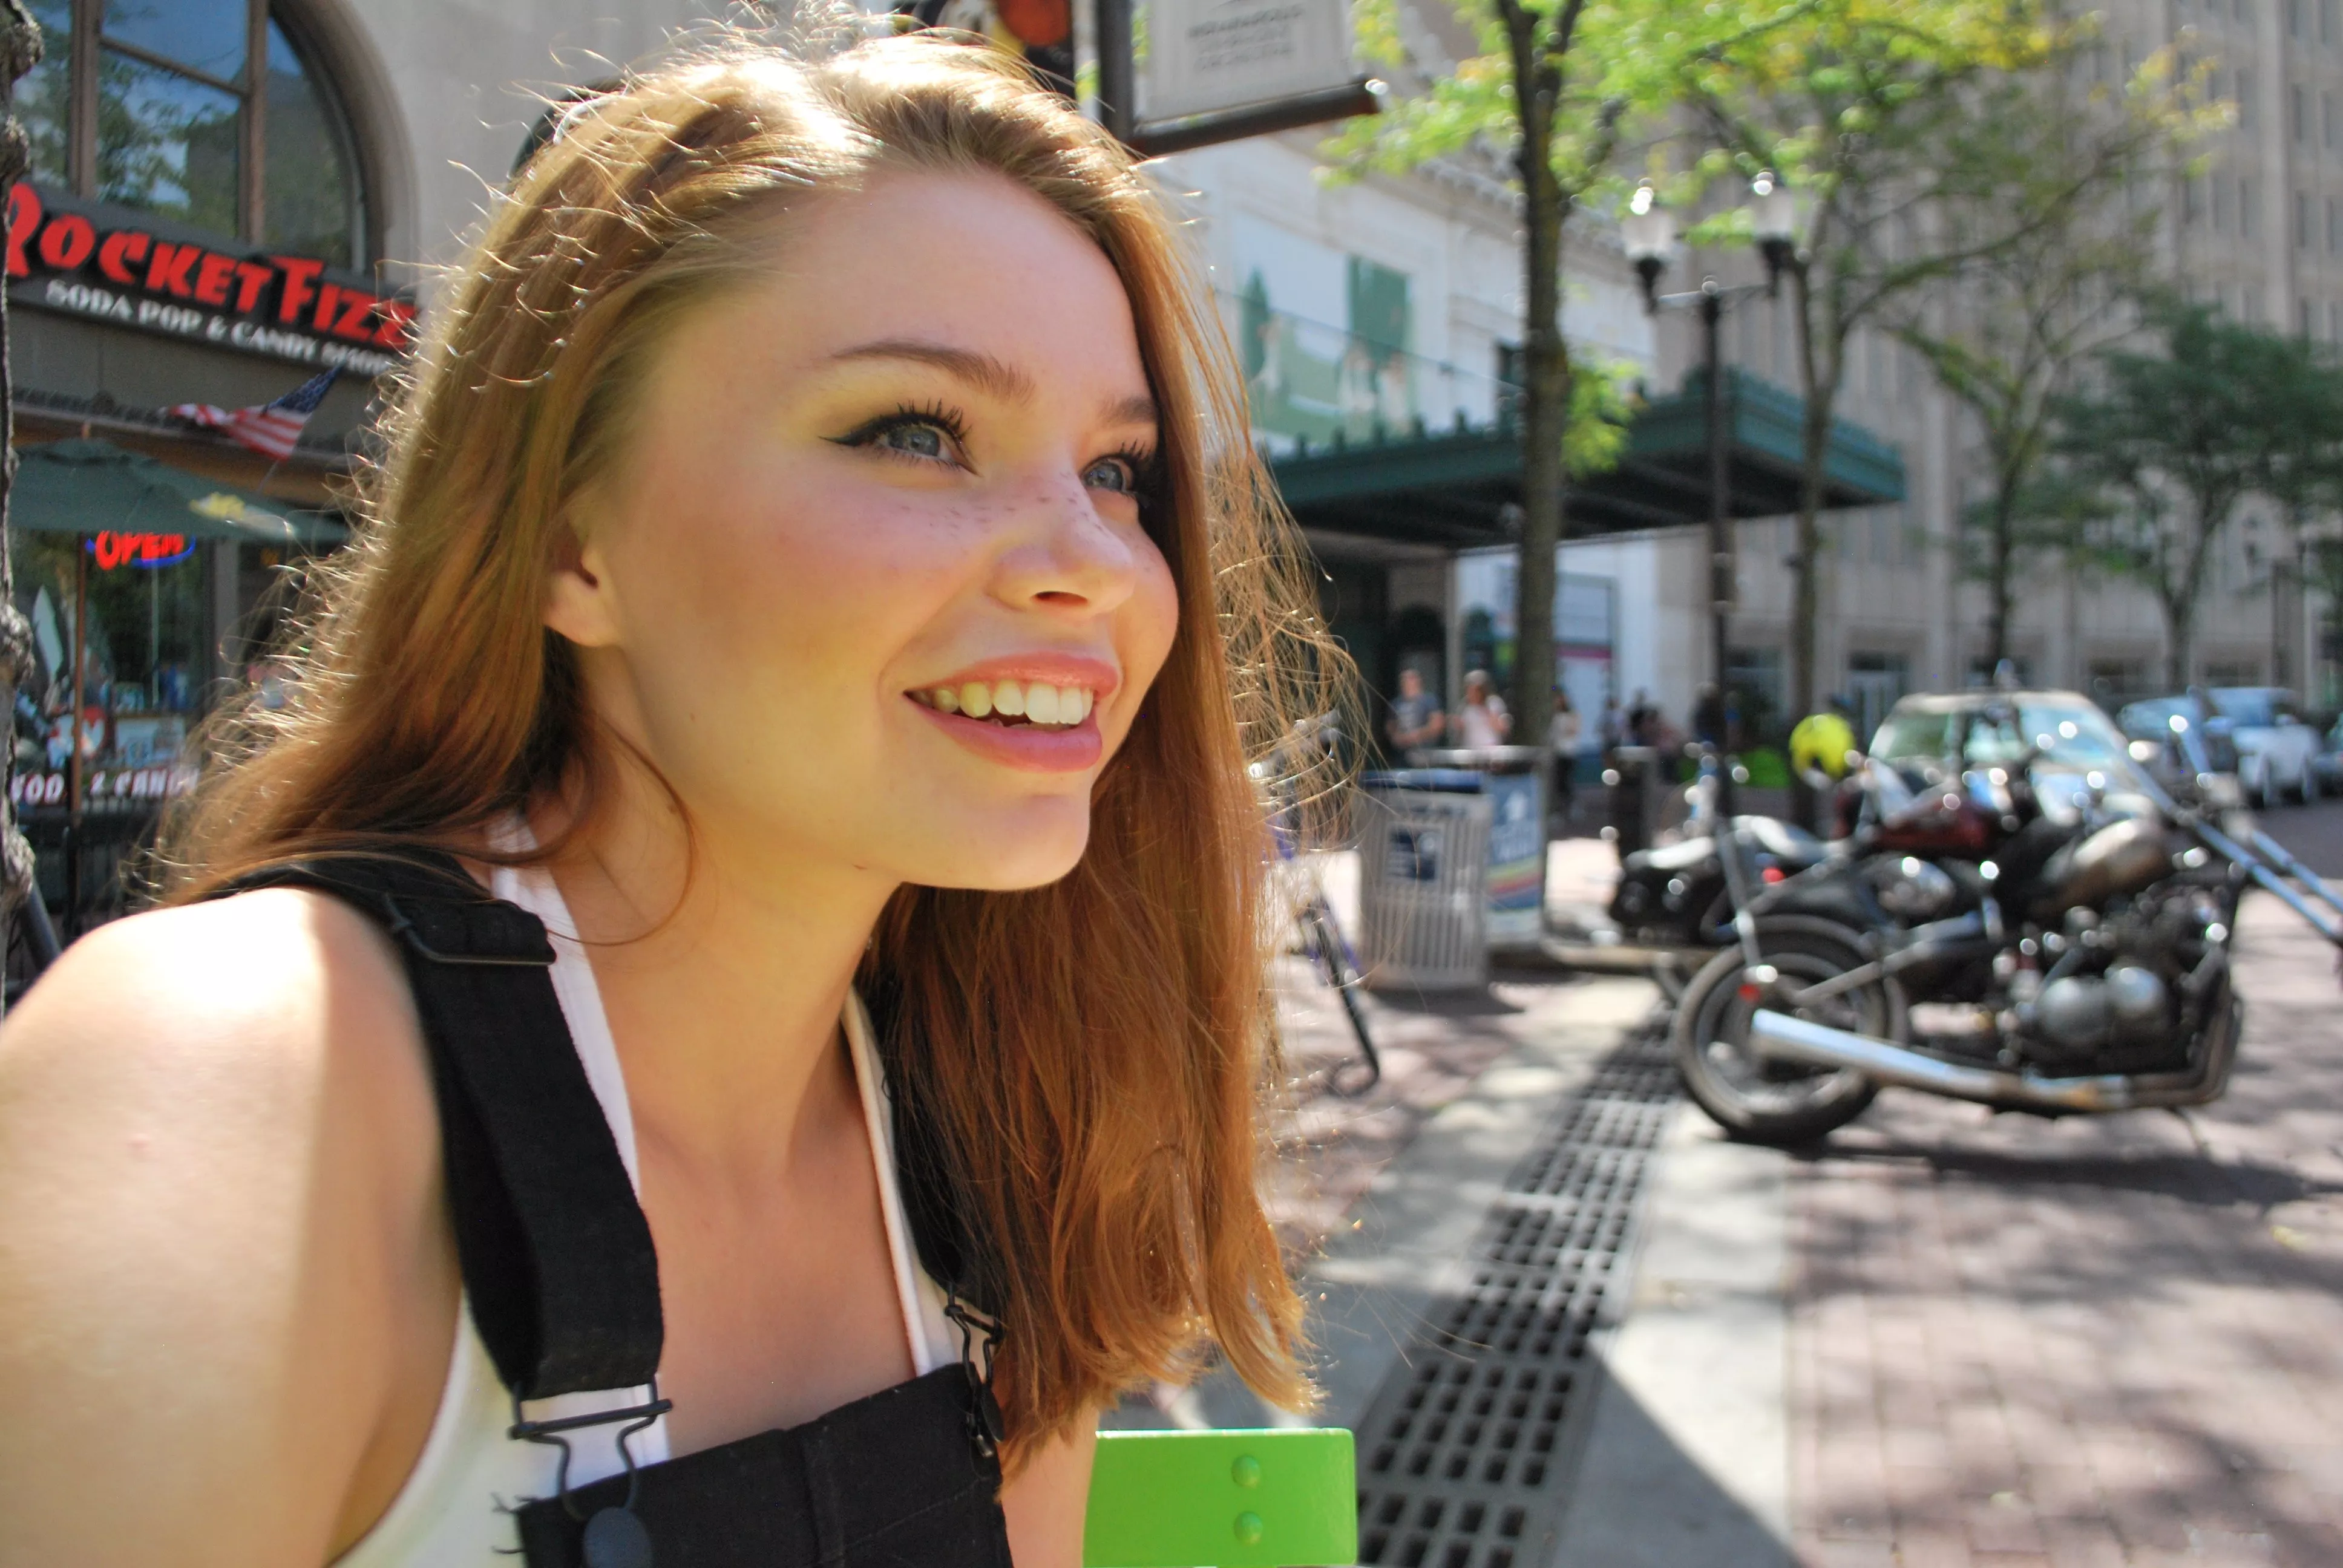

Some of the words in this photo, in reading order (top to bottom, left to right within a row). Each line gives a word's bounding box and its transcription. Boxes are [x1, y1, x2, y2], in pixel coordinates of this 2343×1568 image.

[7, 183, 272, 315] ROCKET
[268, 256, 417, 350] FIZZ
[45, 279, 134, 321] SODA
[138, 299, 203, 333] POP
[206, 315, 227, 341] &
[231, 321, 317, 362] CANDY
[95, 530, 184, 571] OPEN
